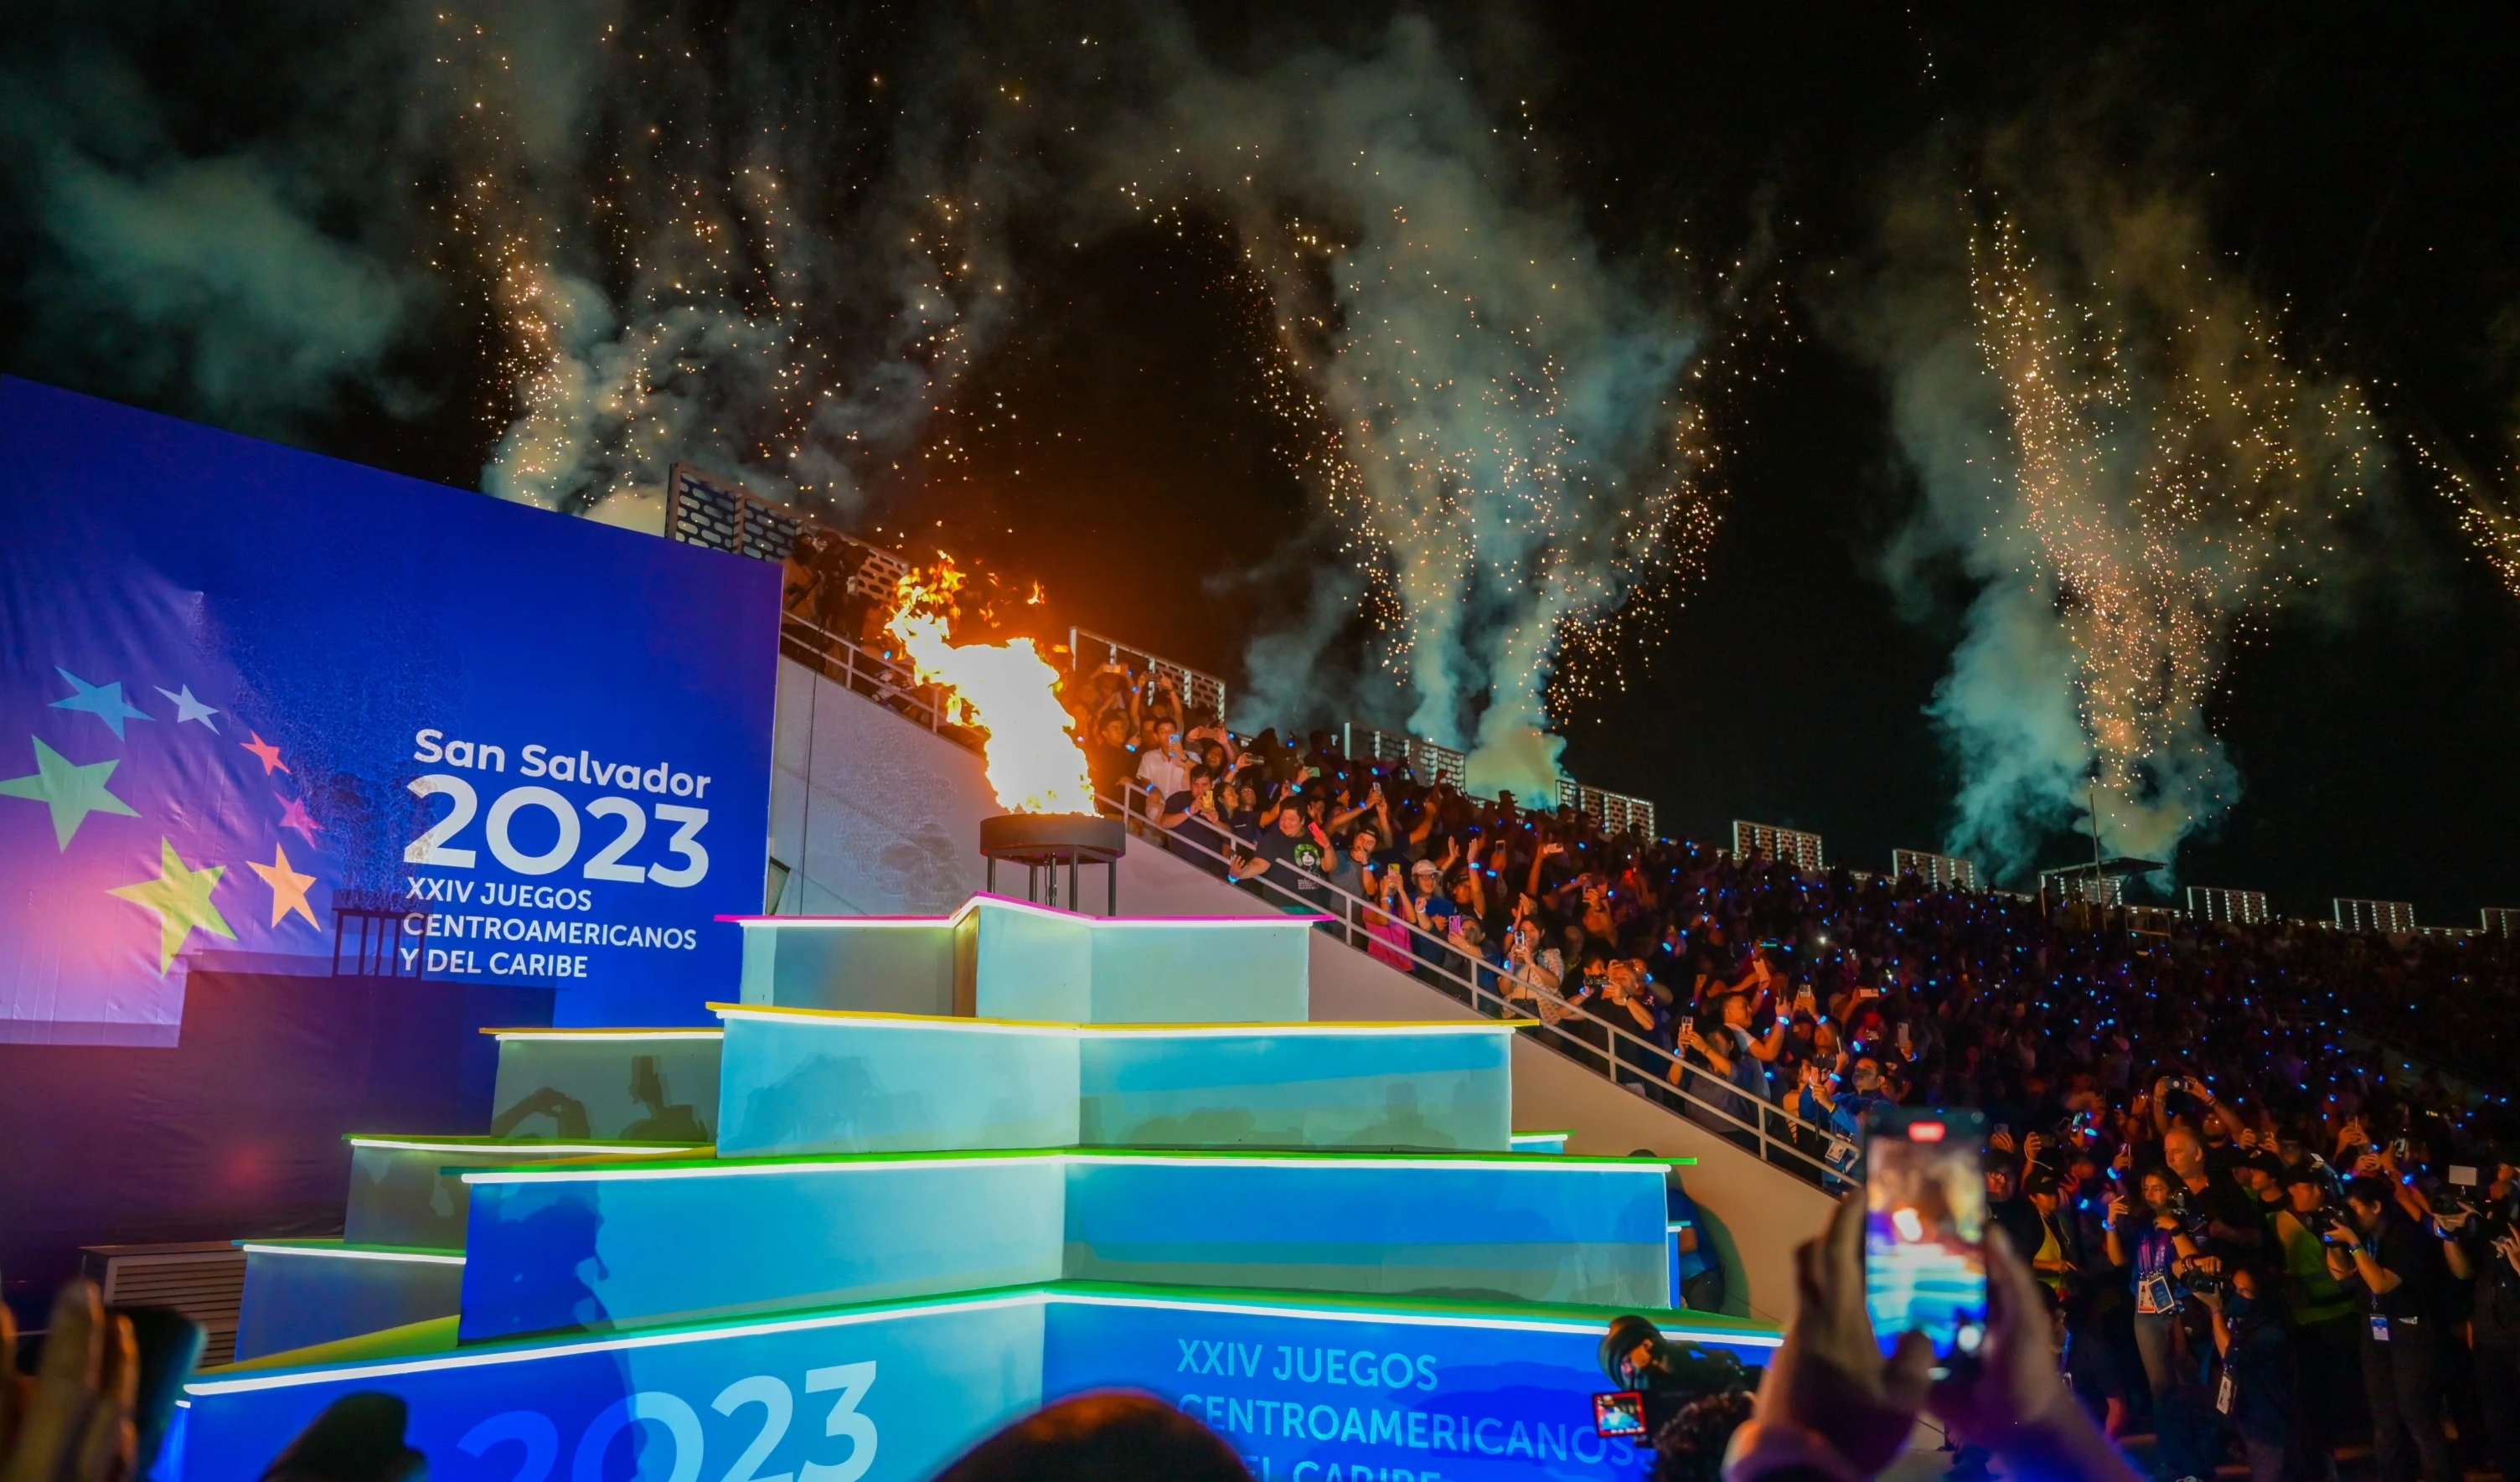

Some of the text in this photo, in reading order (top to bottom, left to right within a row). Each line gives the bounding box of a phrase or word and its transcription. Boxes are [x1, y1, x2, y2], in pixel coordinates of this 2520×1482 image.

[414, 729, 711, 798] San Salvador
[403, 774, 710, 888] 2023
[405, 876, 591, 911] XXIV JUEGOS
[403, 913, 697, 950] CENTROAMERICANOS
[400, 948, 588, 979] Y DEL CARIBE
[1177, 1339, 1438, 1392] XXIV JUEGOS
[457, 1361, 878, 1482] 2023
